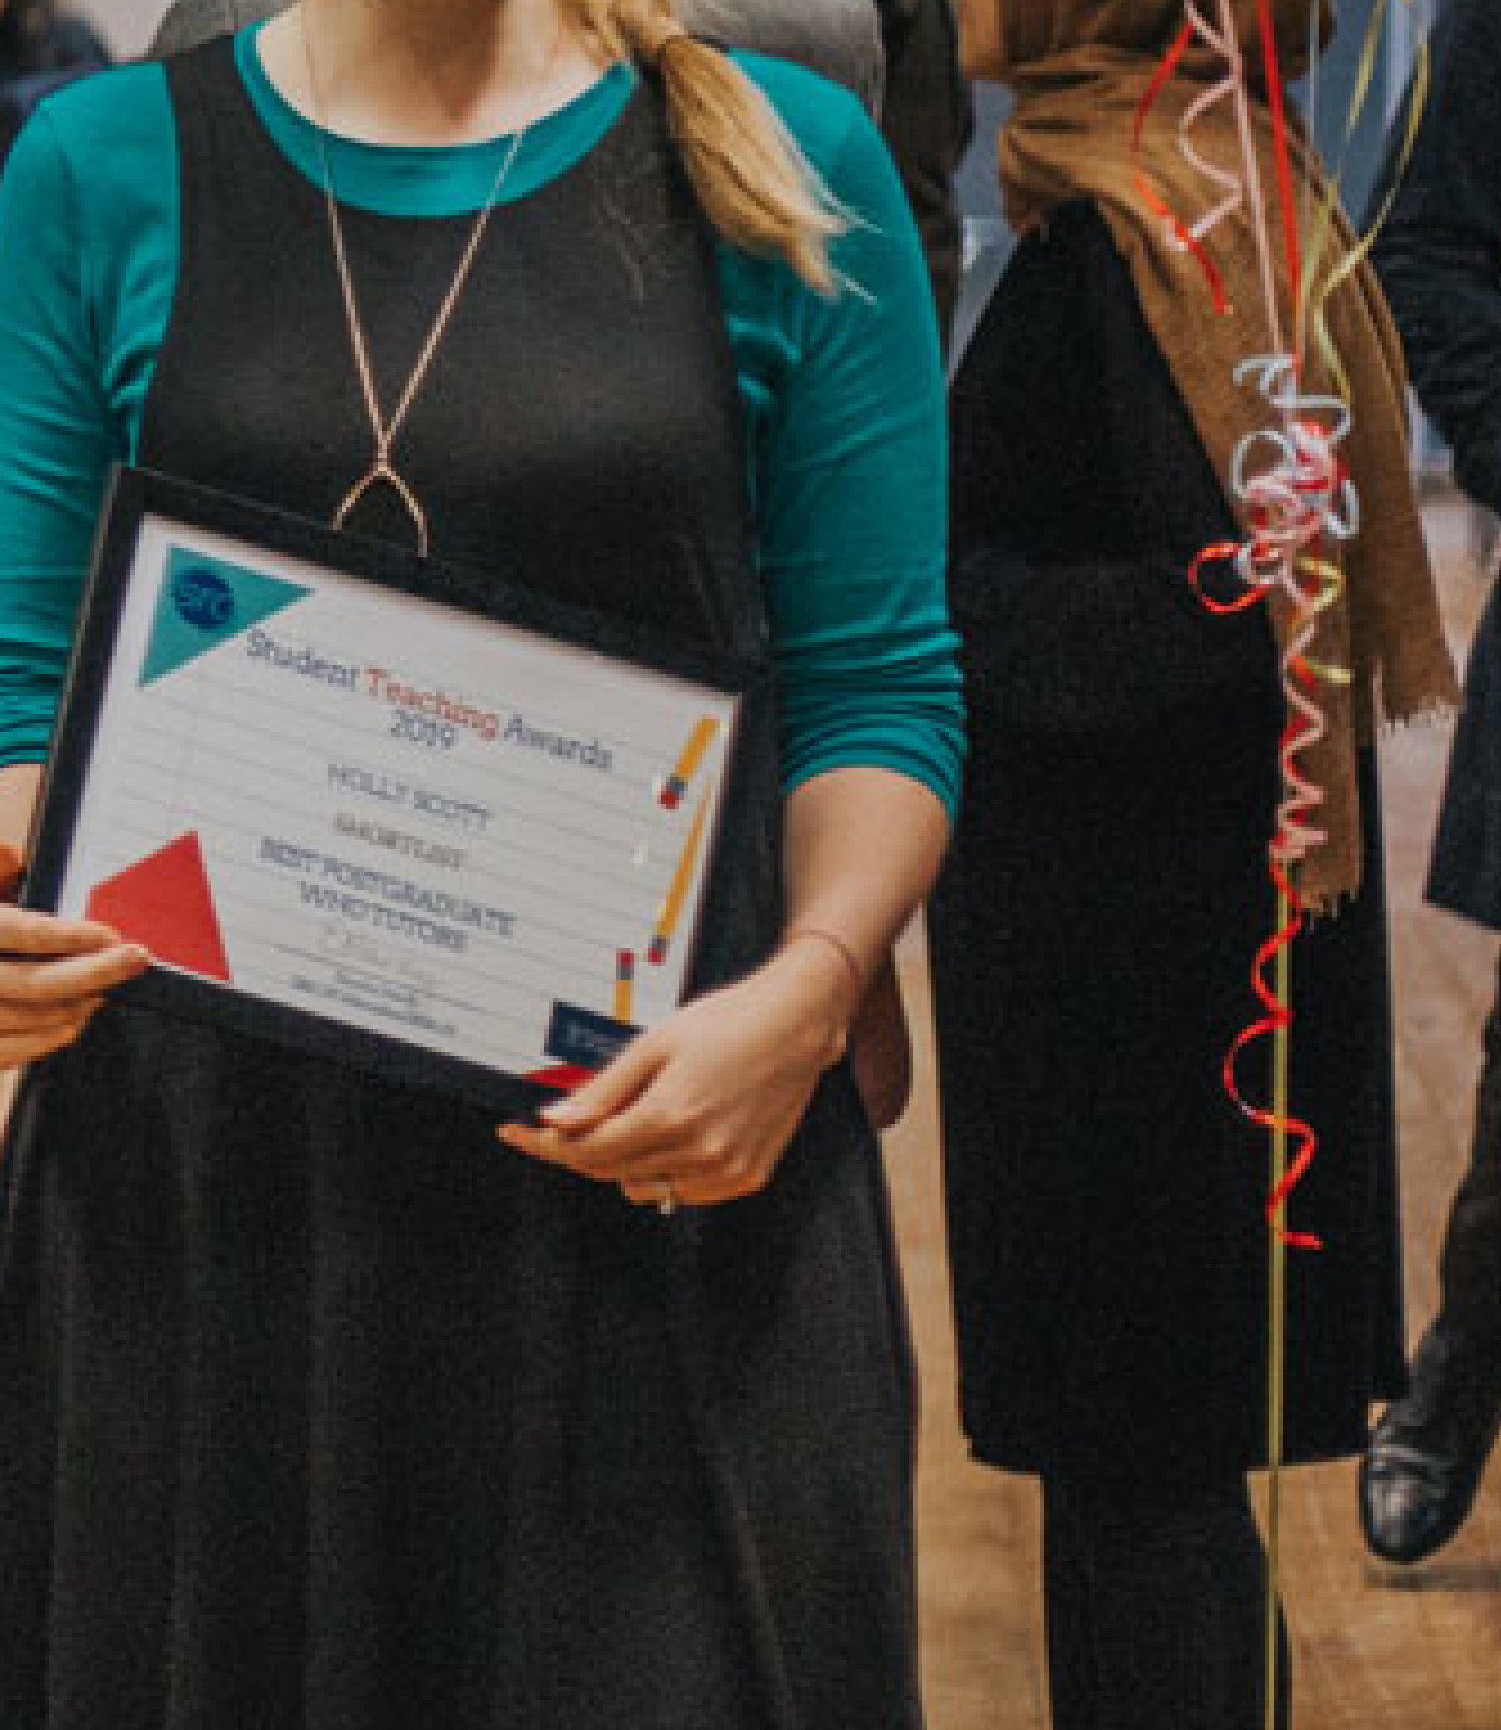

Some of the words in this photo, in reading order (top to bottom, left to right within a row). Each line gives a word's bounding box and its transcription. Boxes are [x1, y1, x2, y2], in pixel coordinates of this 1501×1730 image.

[247, 629, 360, 692] Student
[364, 668, 500, 742] Teaching
[504, 713, 613, 772] Awards
[391, 710, 459, 749] 2019
